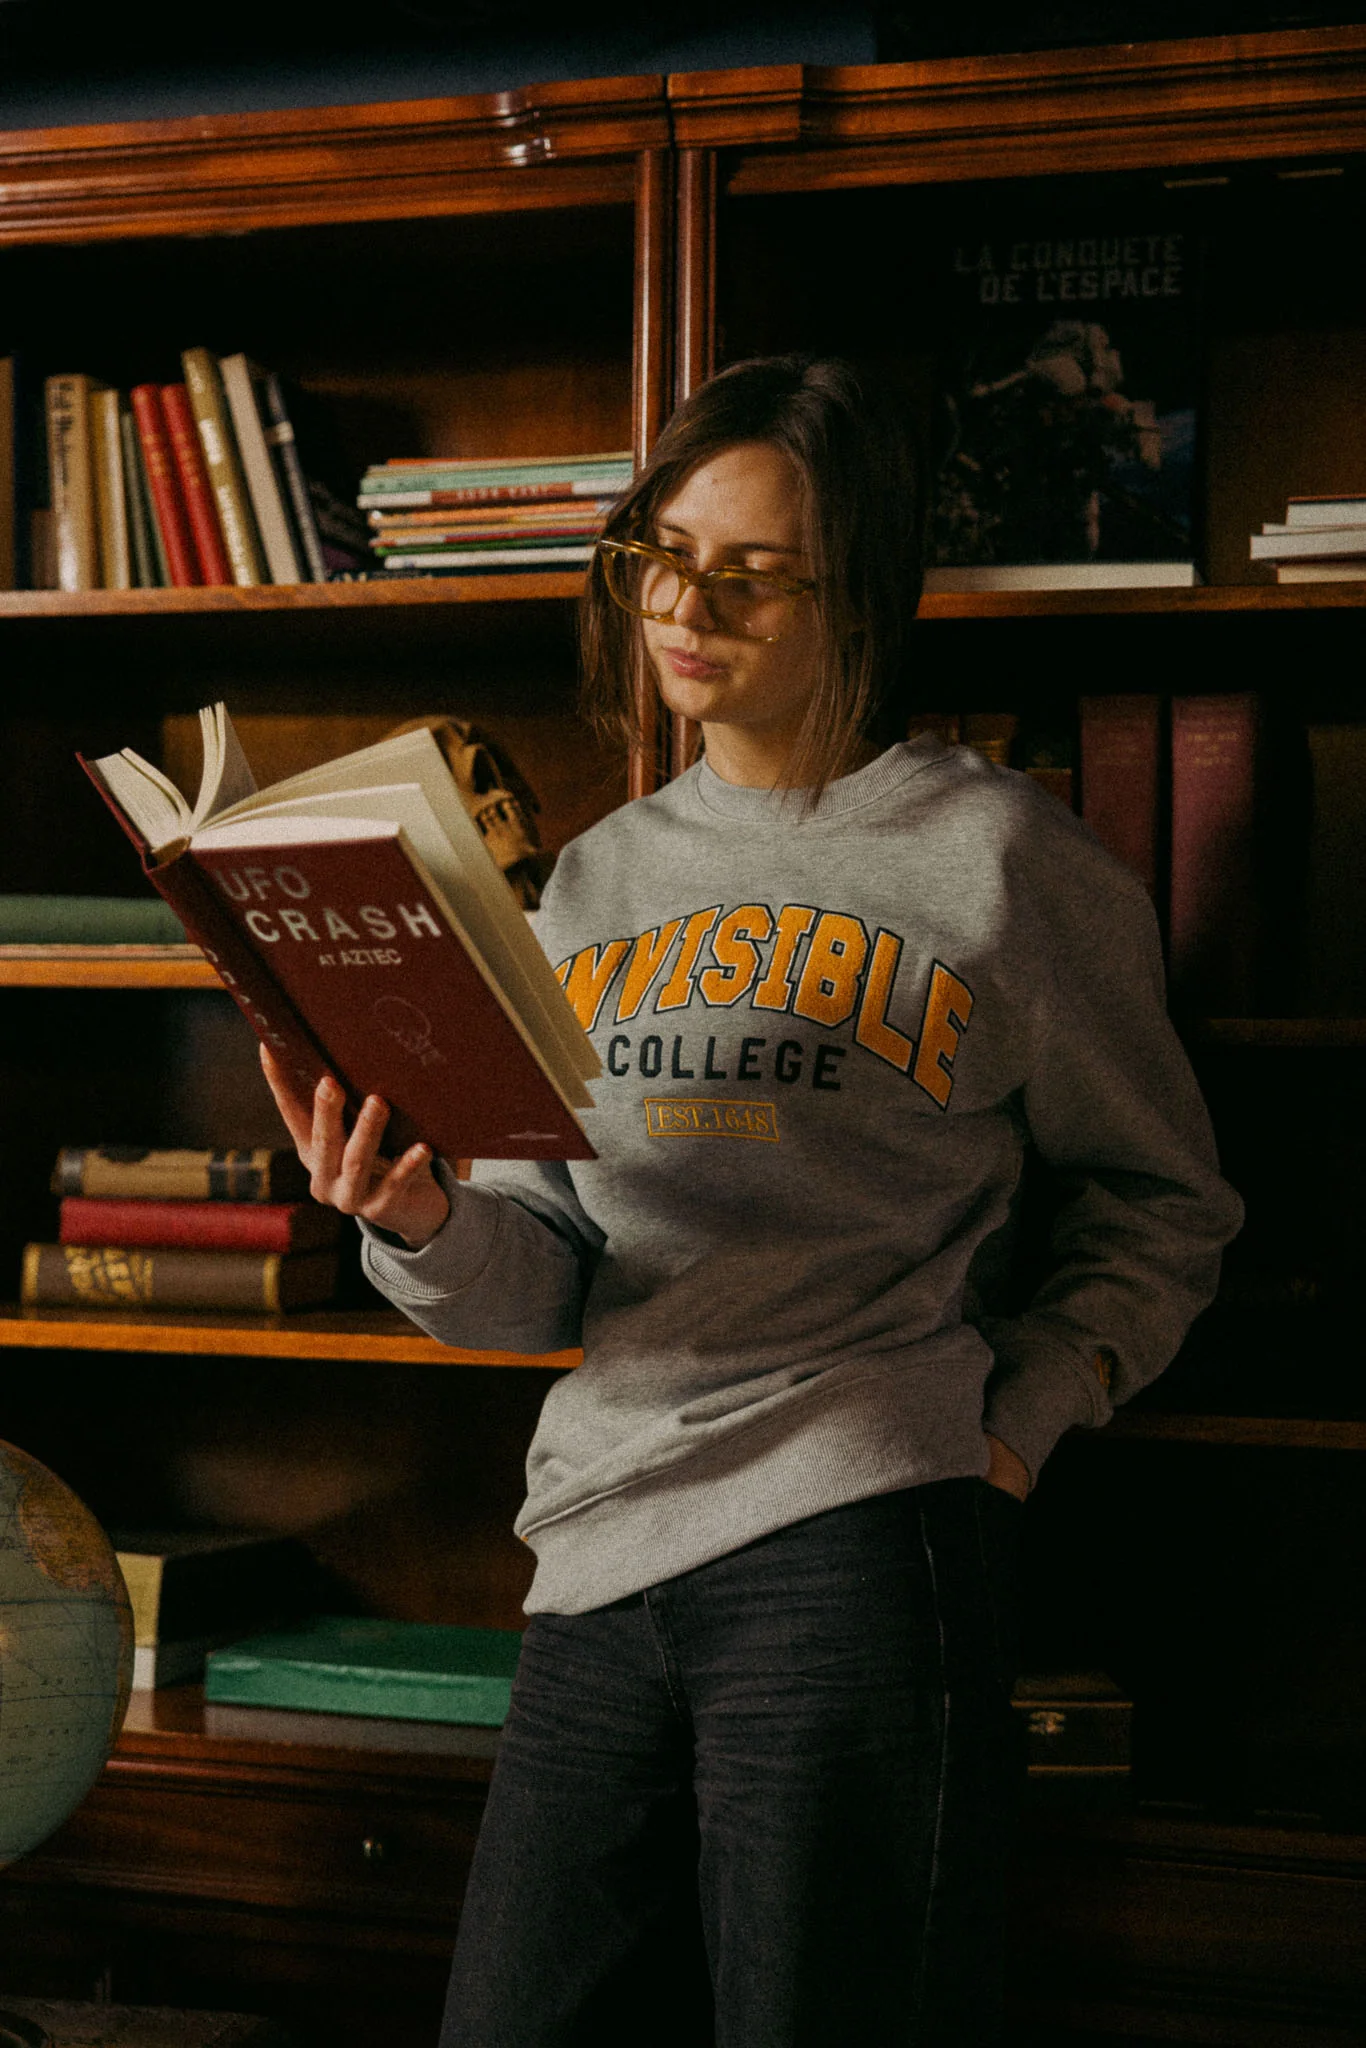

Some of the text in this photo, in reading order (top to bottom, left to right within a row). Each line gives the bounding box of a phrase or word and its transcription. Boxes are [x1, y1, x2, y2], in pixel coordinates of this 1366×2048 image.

[953, 243, 995, 273] LA
[979, 265, 1183, 304] DE L'ESPACE
[215, 865, 310, 900] UFO
[244, 902, 442, 942] CRASH
[339, 948, 402, 967] AZTEC
[554, 903, 975, 1112] NVISIBLE
[608, 1034, 847, 1091] COLLEGE
